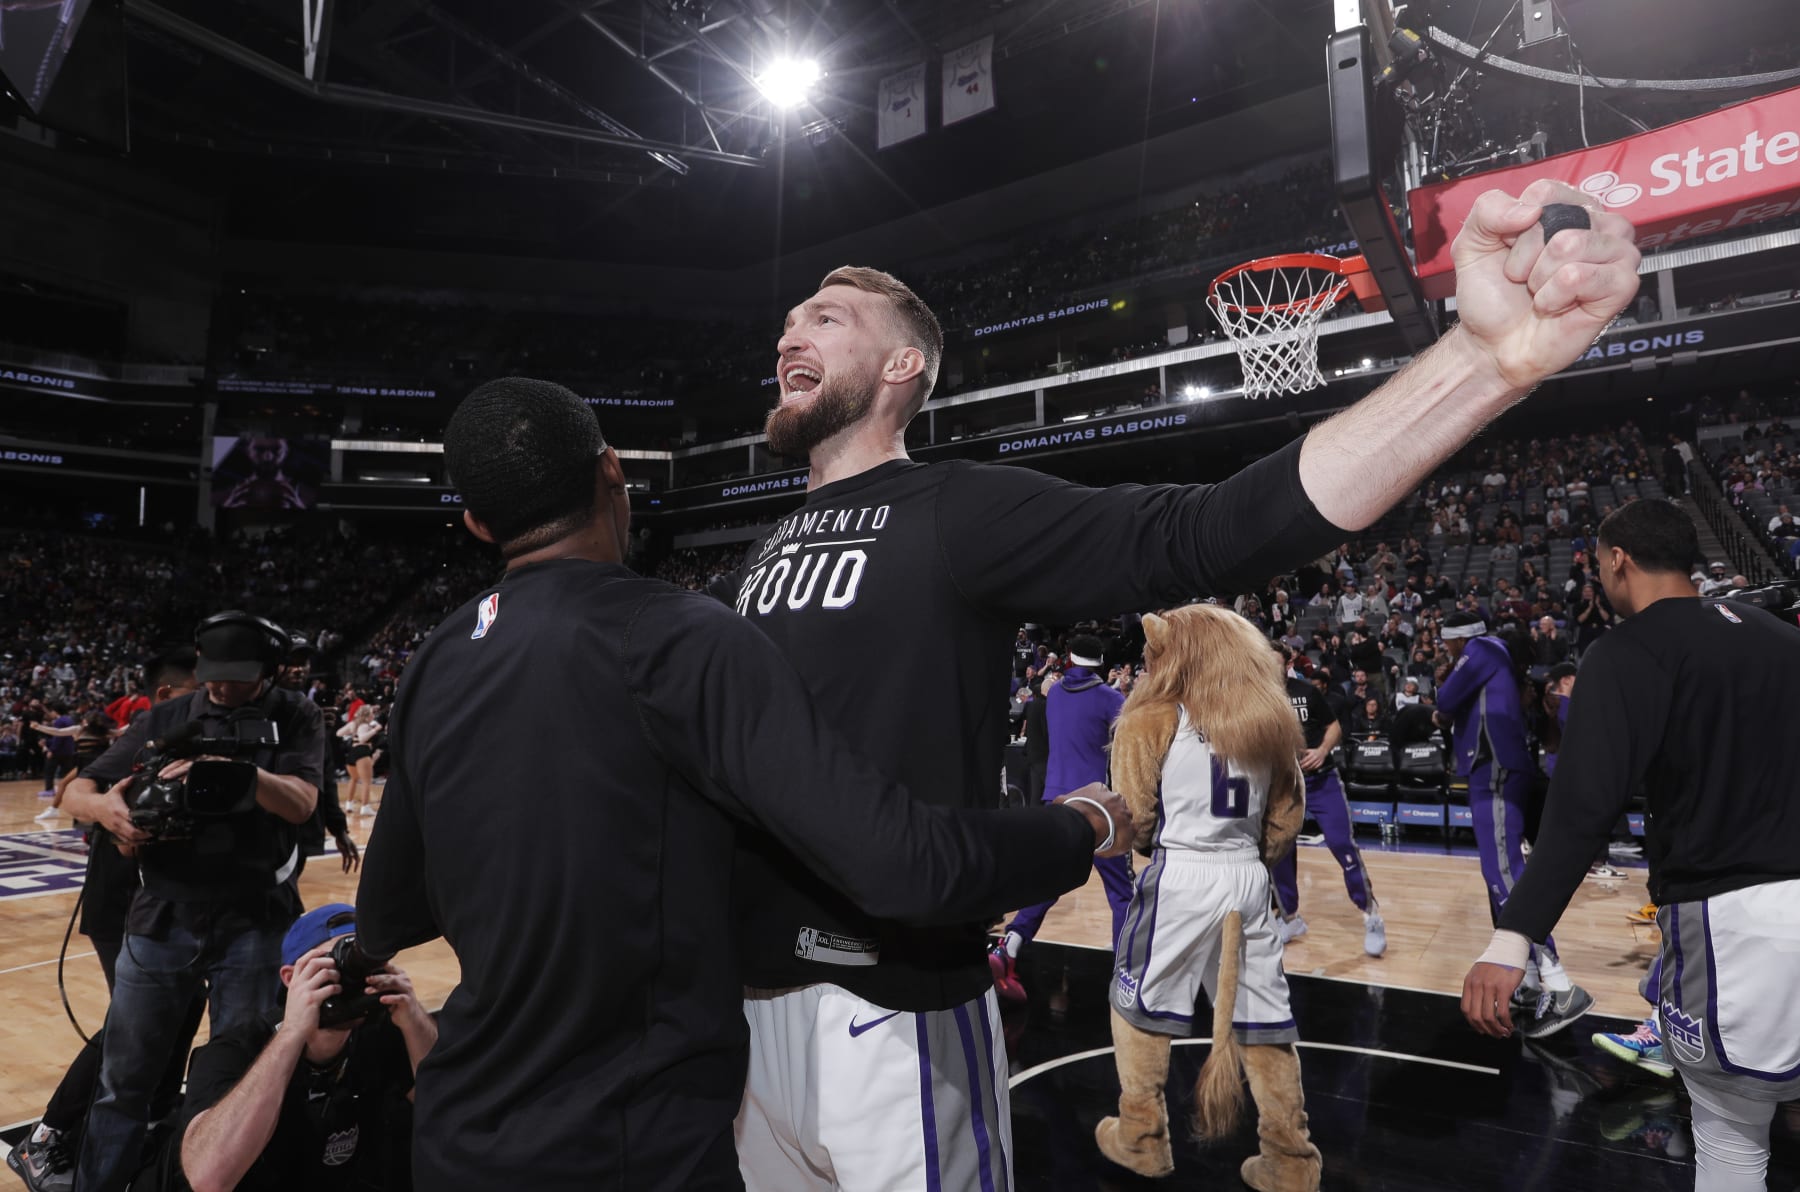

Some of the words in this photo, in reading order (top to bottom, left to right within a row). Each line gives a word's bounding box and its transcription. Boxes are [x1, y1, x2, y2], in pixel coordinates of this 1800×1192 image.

[1650, 130, 1800, 196] State
[1636, 219, 1722, 247] ate
[974, 313, 1045, 337] DOMANTAS
[1047, 298, 1109, 319] SABONIS
[1576, 330, 1705, 361] ABONIS
[0, 370, 76, 389] ABONIS
[380, 388, 436, 398] SABONIS
[581, 397, 621, 406] ANTAS
[624, 399, 675, 407] SABONIS
[999, 428, 1095, 453] DOMANTAS
[1101, 414, 1187, 437] SABONIS
[0, 450, 63, 465] BONIS
[722, 479, 789, 497] DOMANTAS
[1210, 753, 1249, 818] 6
